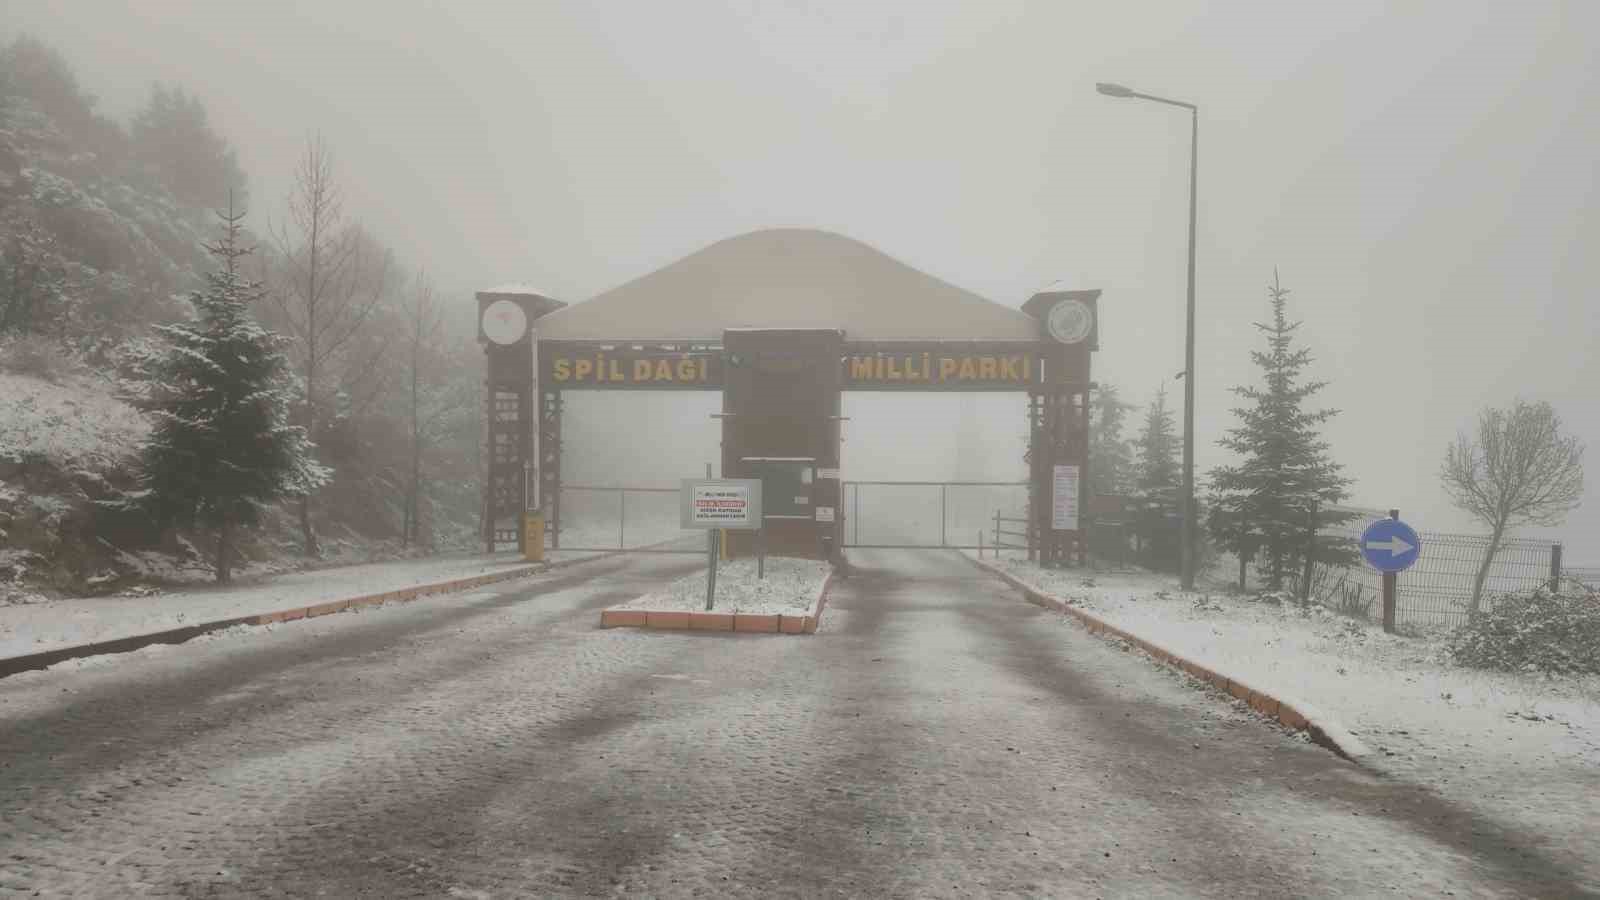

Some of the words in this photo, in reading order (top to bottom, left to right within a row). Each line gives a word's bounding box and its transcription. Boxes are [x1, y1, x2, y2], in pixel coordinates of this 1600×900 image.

[552, 352, 625, 381] SPİL
[633, 352, 707, 381] DAĞI
[851, 352, 930, 380] MİLLİ
[939, 355, 1031, 380] PARKI
